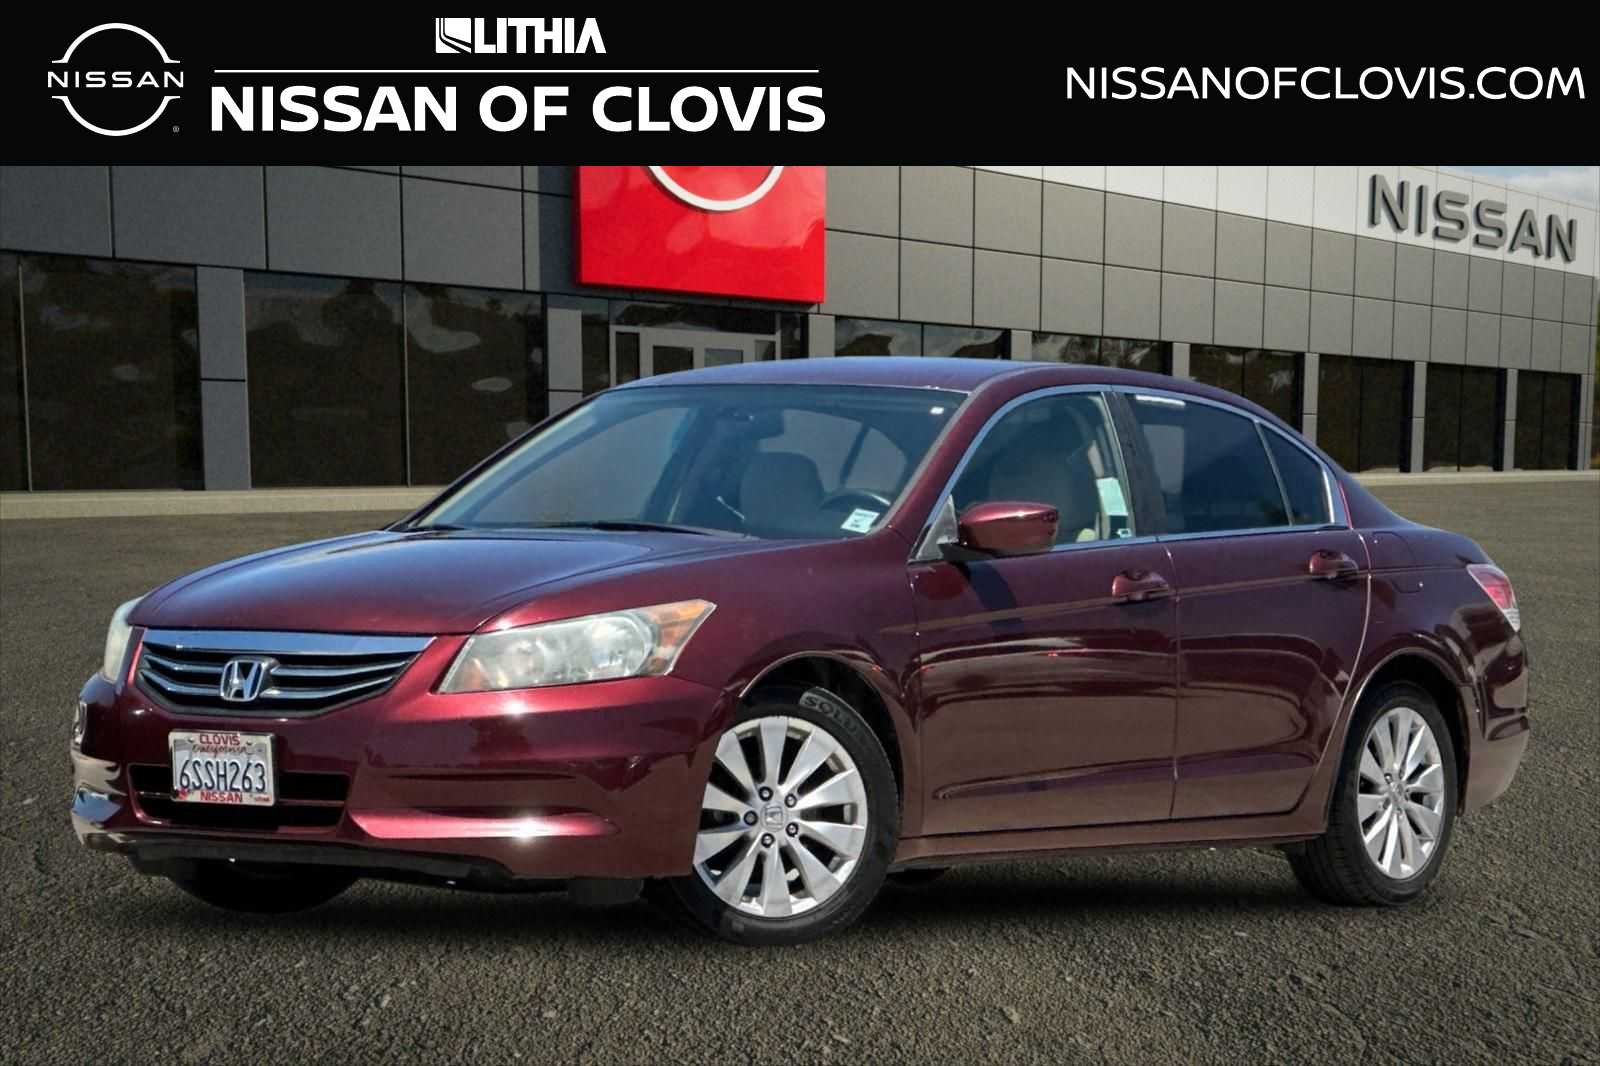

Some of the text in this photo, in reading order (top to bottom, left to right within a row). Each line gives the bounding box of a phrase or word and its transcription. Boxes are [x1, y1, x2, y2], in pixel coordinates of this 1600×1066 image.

[1368, 173, 1578, 264] NISSAN
[199, 734, 241, 746] CLOVIS
[180, 759, 266, 792] 6SSH263
[200, 790, 243, 803] NISSAN
